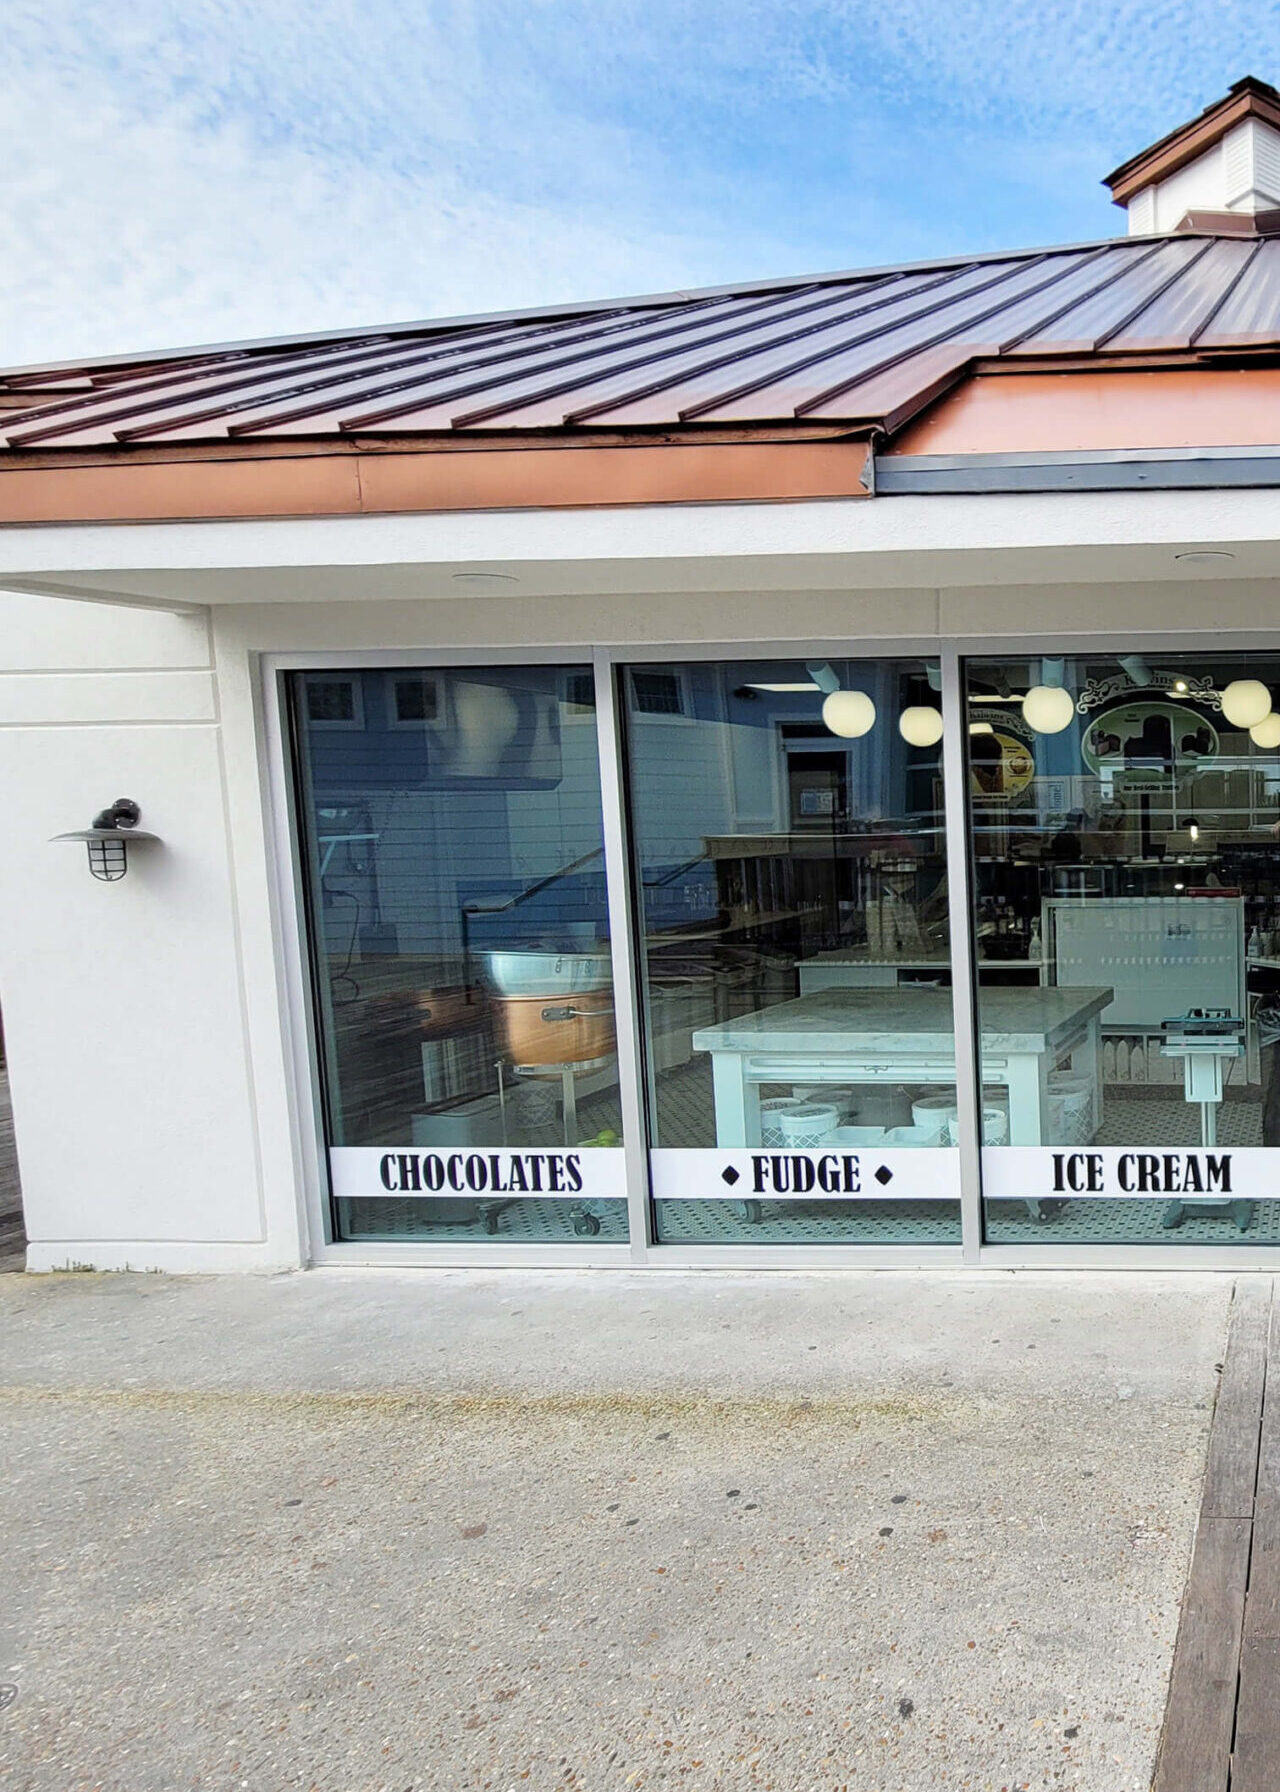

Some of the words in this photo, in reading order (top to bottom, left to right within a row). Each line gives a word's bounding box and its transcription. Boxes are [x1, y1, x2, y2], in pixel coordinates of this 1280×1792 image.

[378, 1154, 583, 1193] CHOCOLATES
[751, 1154, 862, 1194] FUDGE
[1052, 1153, 1104, 1192] ICE
[1117, 1154, 1233, 1193] CREAM
